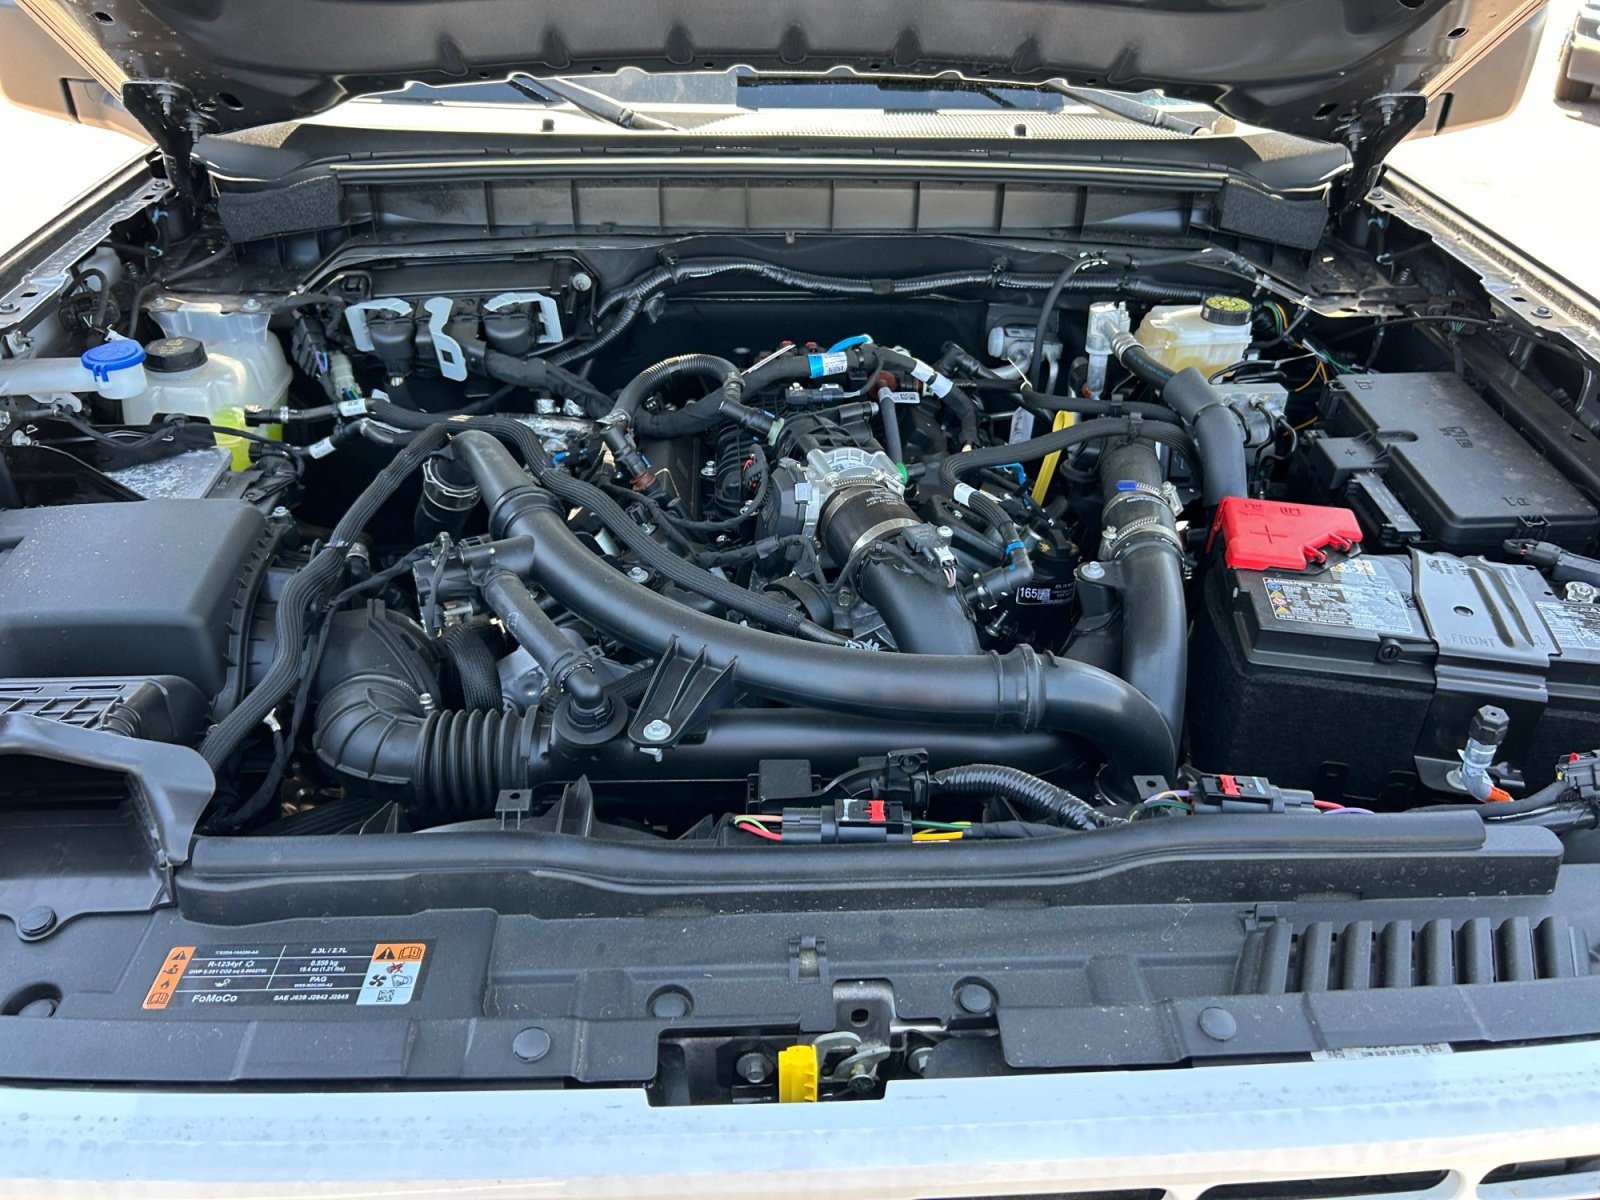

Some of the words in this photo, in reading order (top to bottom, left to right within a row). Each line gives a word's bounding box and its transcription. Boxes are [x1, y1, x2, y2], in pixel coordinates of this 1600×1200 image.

[1020, 587, 1037, 599] 165
[1451, 633, 1495, 648] FRONT
[207, 960, 244, 968] R-1234yf
[191, 994, 238, 1003] FoMoCo
